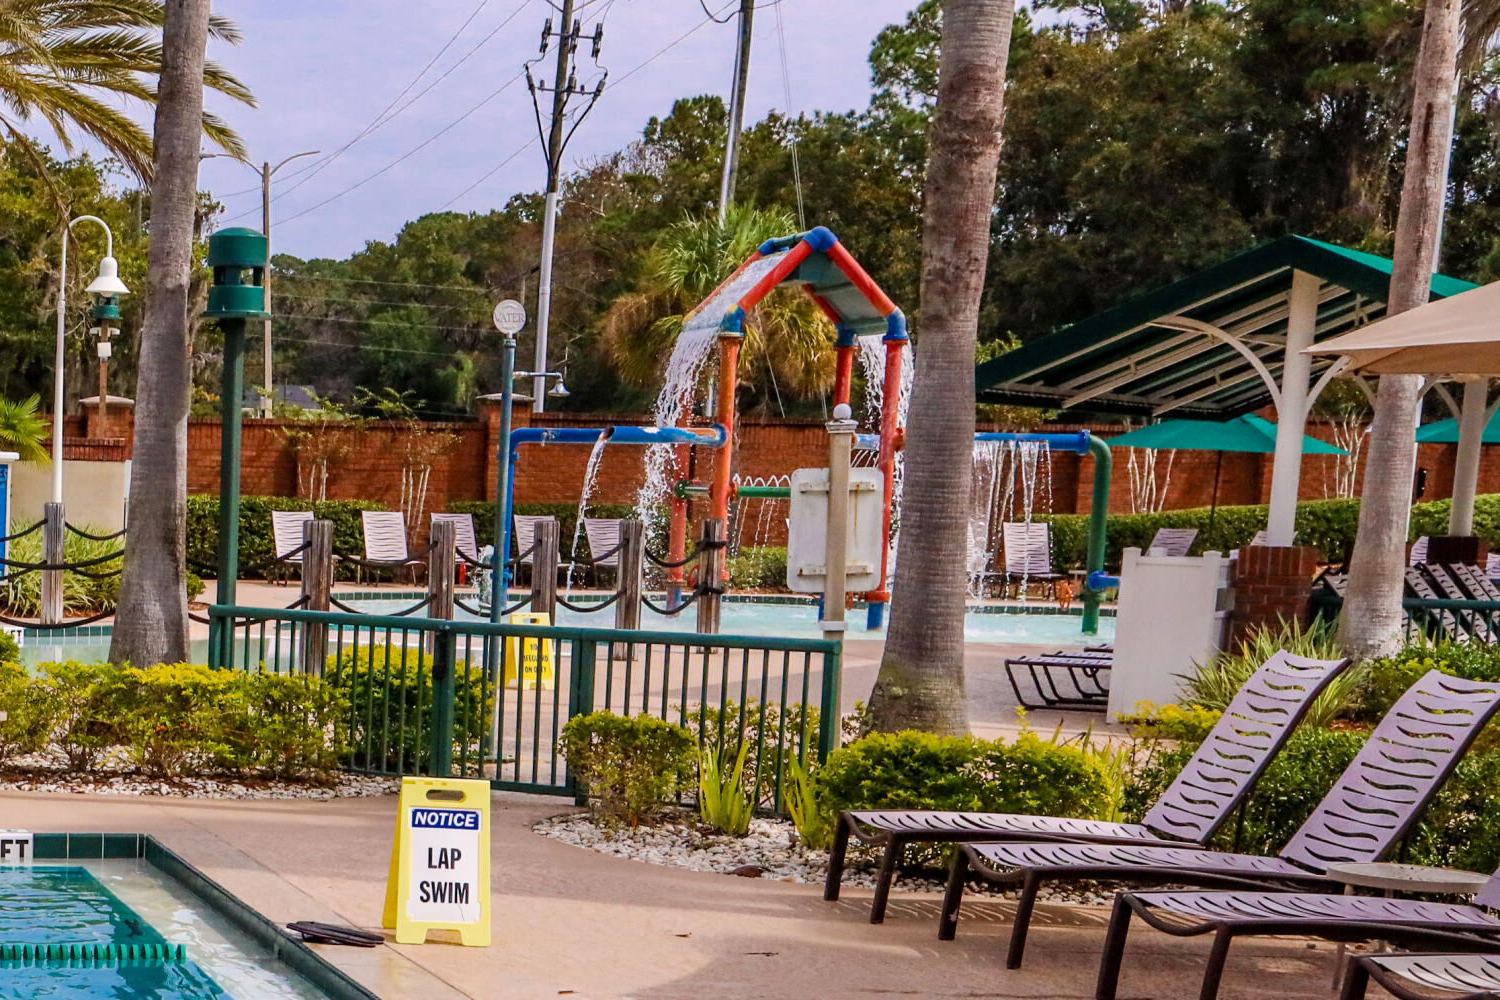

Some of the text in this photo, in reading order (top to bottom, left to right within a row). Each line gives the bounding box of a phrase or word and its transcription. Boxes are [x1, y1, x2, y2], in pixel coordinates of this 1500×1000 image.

[495, 312, 525, 323] WATER
[414, 811, 477, 828] NOTICE
[1, 839, 29, 858] FT
[427, 847, 462, 870] LAP
[419, 880, 469, 904] SWIM
